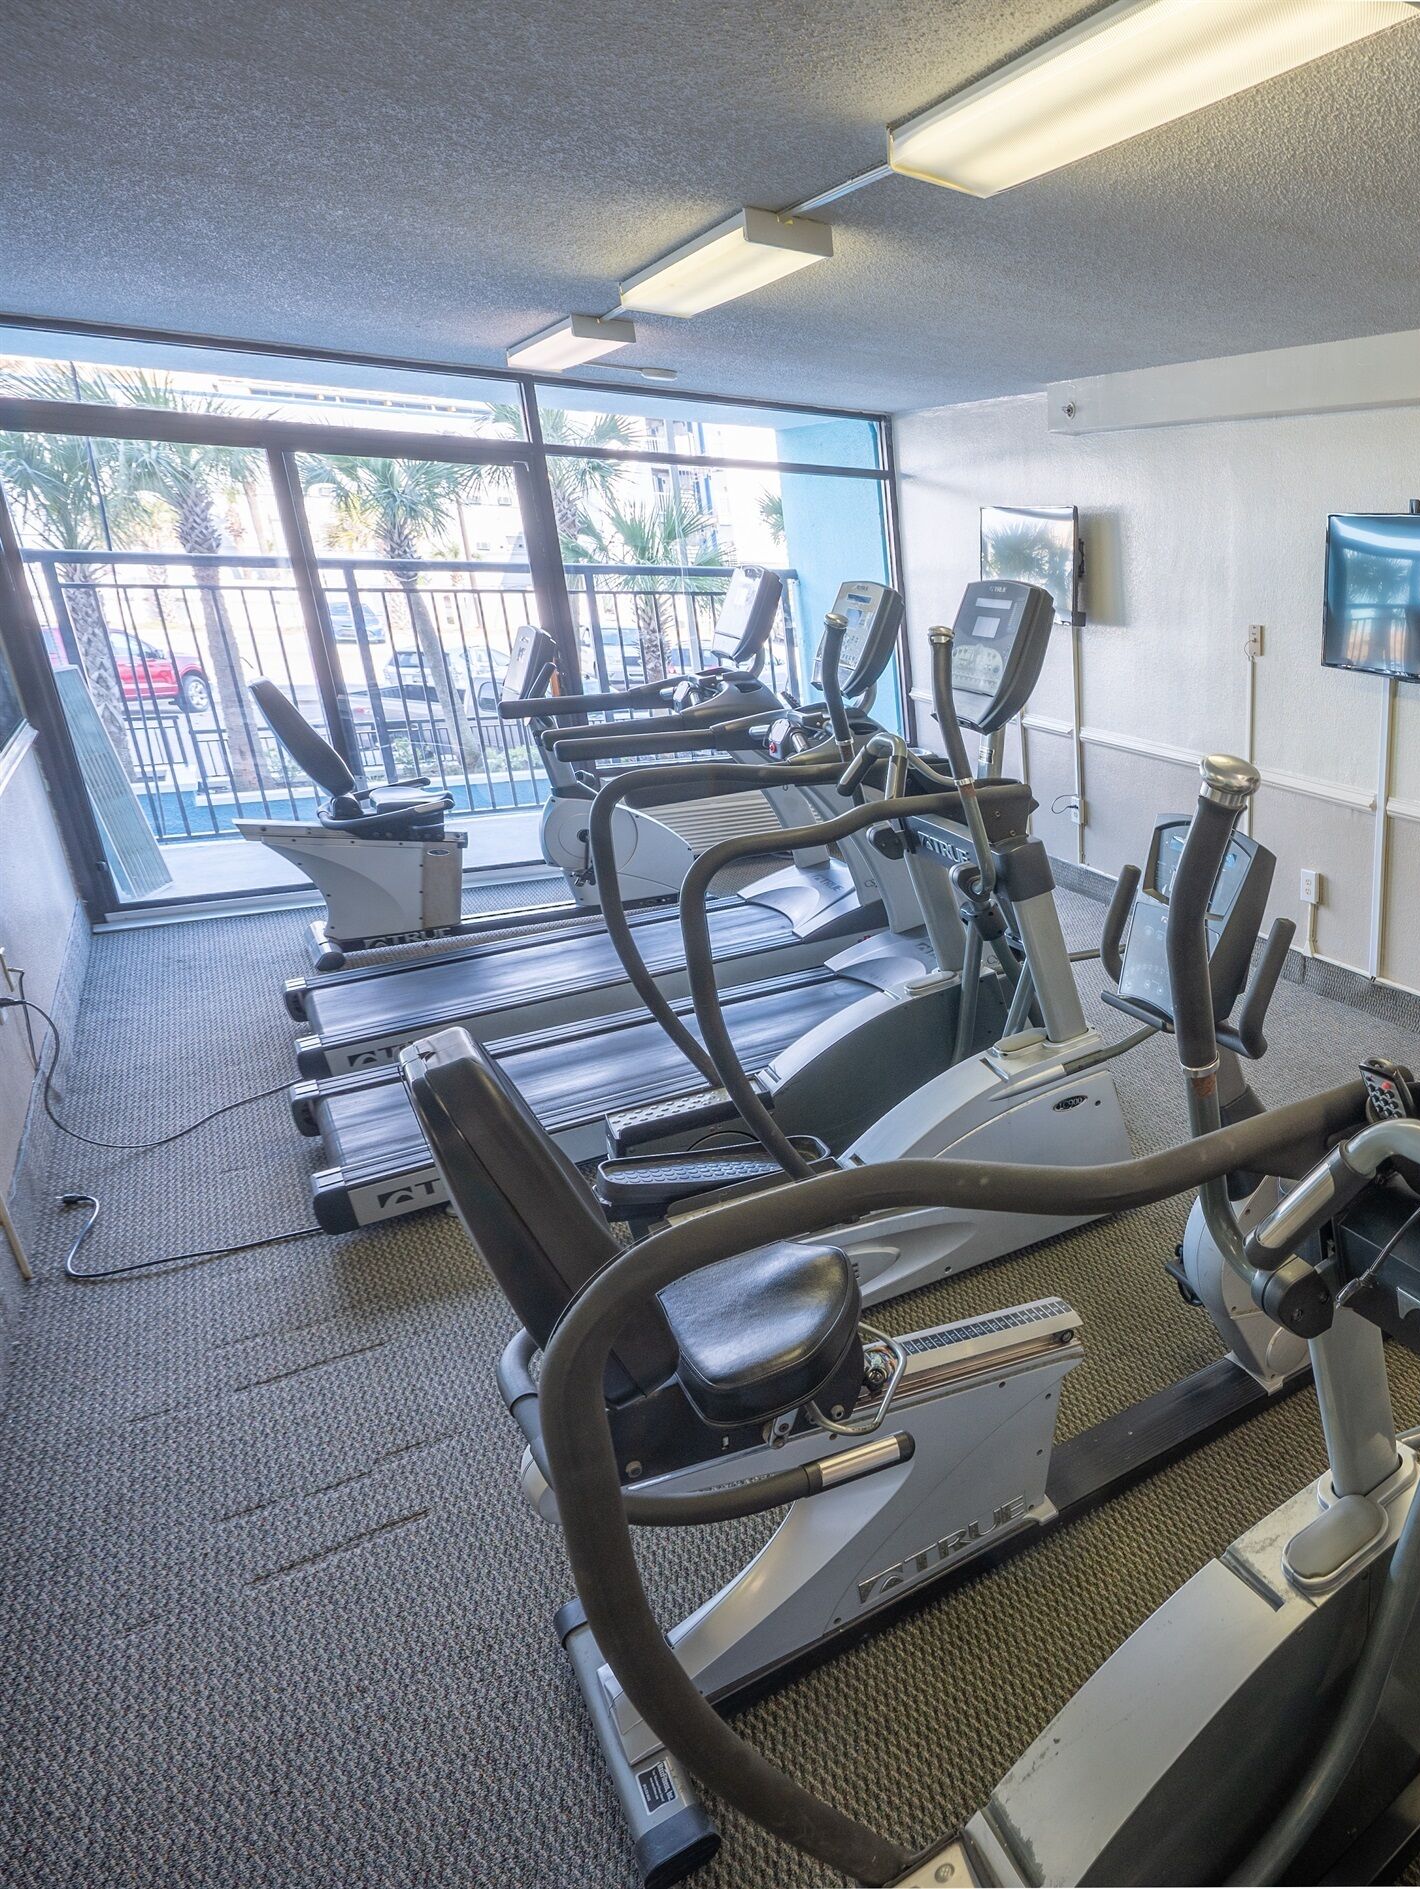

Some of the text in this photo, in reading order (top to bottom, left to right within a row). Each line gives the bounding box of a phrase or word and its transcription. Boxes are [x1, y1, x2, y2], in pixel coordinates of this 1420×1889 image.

[929, 836, 969, 863] TRUE
[387, 927, 451, 945] TRUE
[904, 1495, 1025, 1573] TRUE
